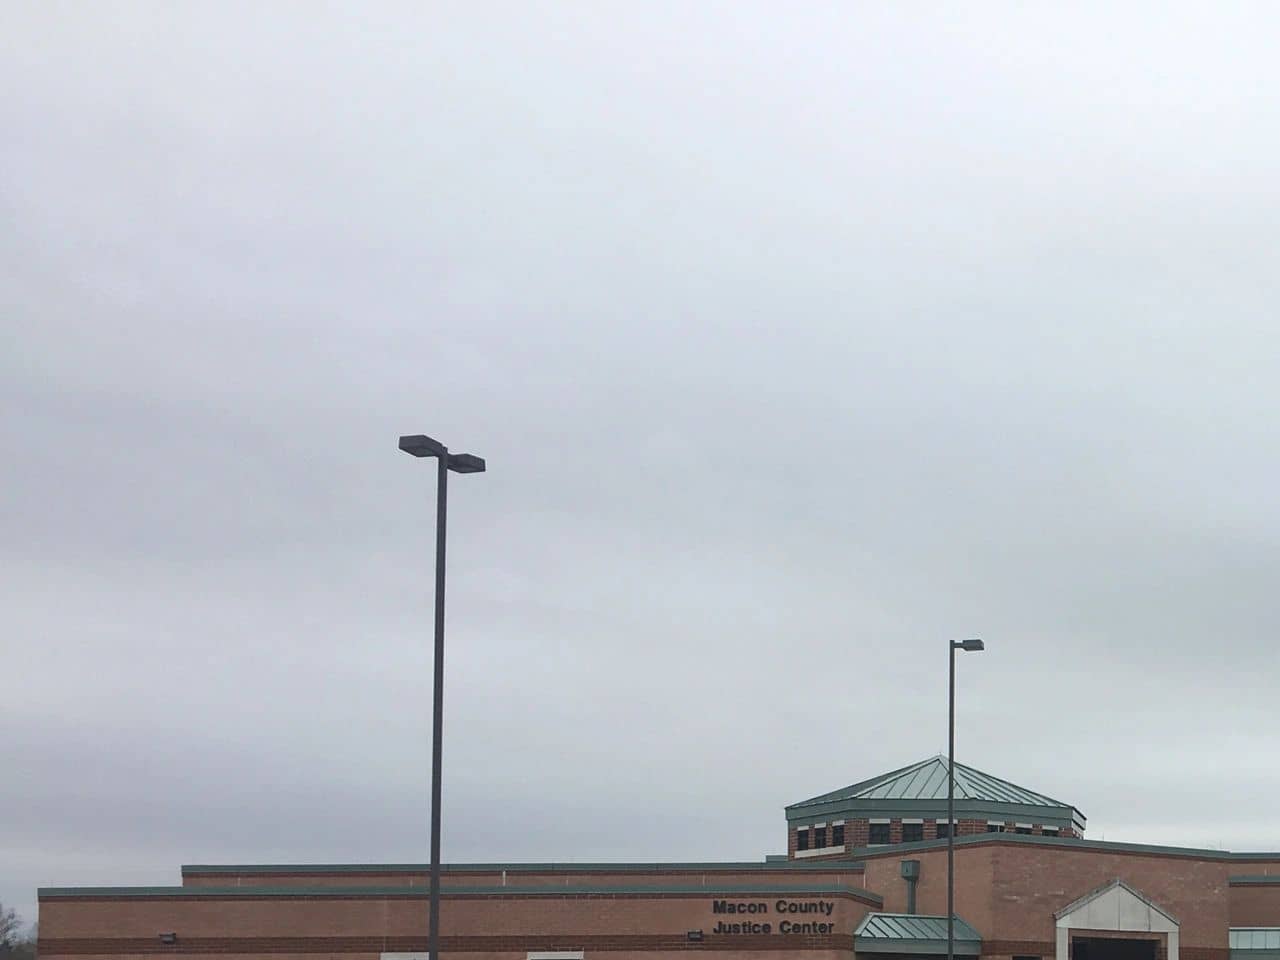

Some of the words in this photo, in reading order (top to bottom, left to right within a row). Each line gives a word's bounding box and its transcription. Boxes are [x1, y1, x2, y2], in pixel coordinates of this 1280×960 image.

[713, 900, 767, 914] Macon
[775, 900, 834, 915] County
[713, 921, 771, 934] Justice
[779, 921, 835, 934] Center
